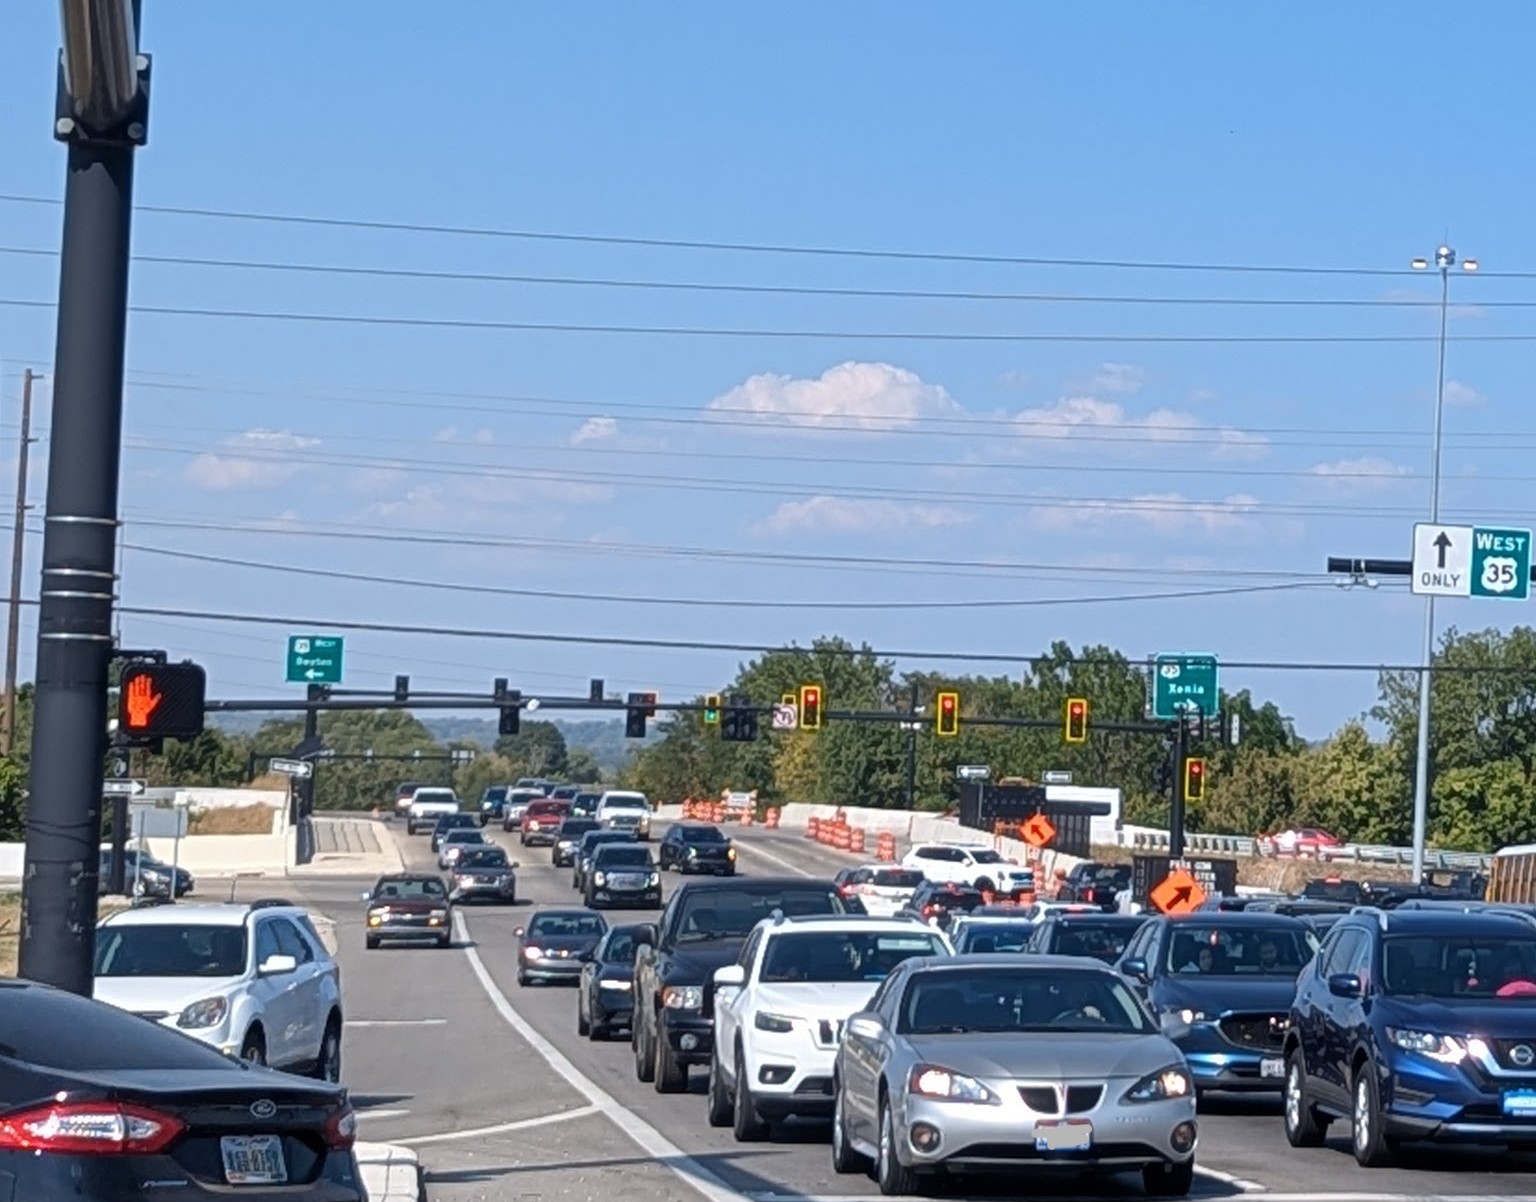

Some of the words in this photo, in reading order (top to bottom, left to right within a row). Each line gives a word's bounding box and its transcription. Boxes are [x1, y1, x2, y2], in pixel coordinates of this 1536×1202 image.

[1476, 532, 1527, 551] WEST
[1421, 571, 1461, 588] ONLY
[1486, 562, 1514, 584] 35
[1167, 683, 1205, 695] Xenia
